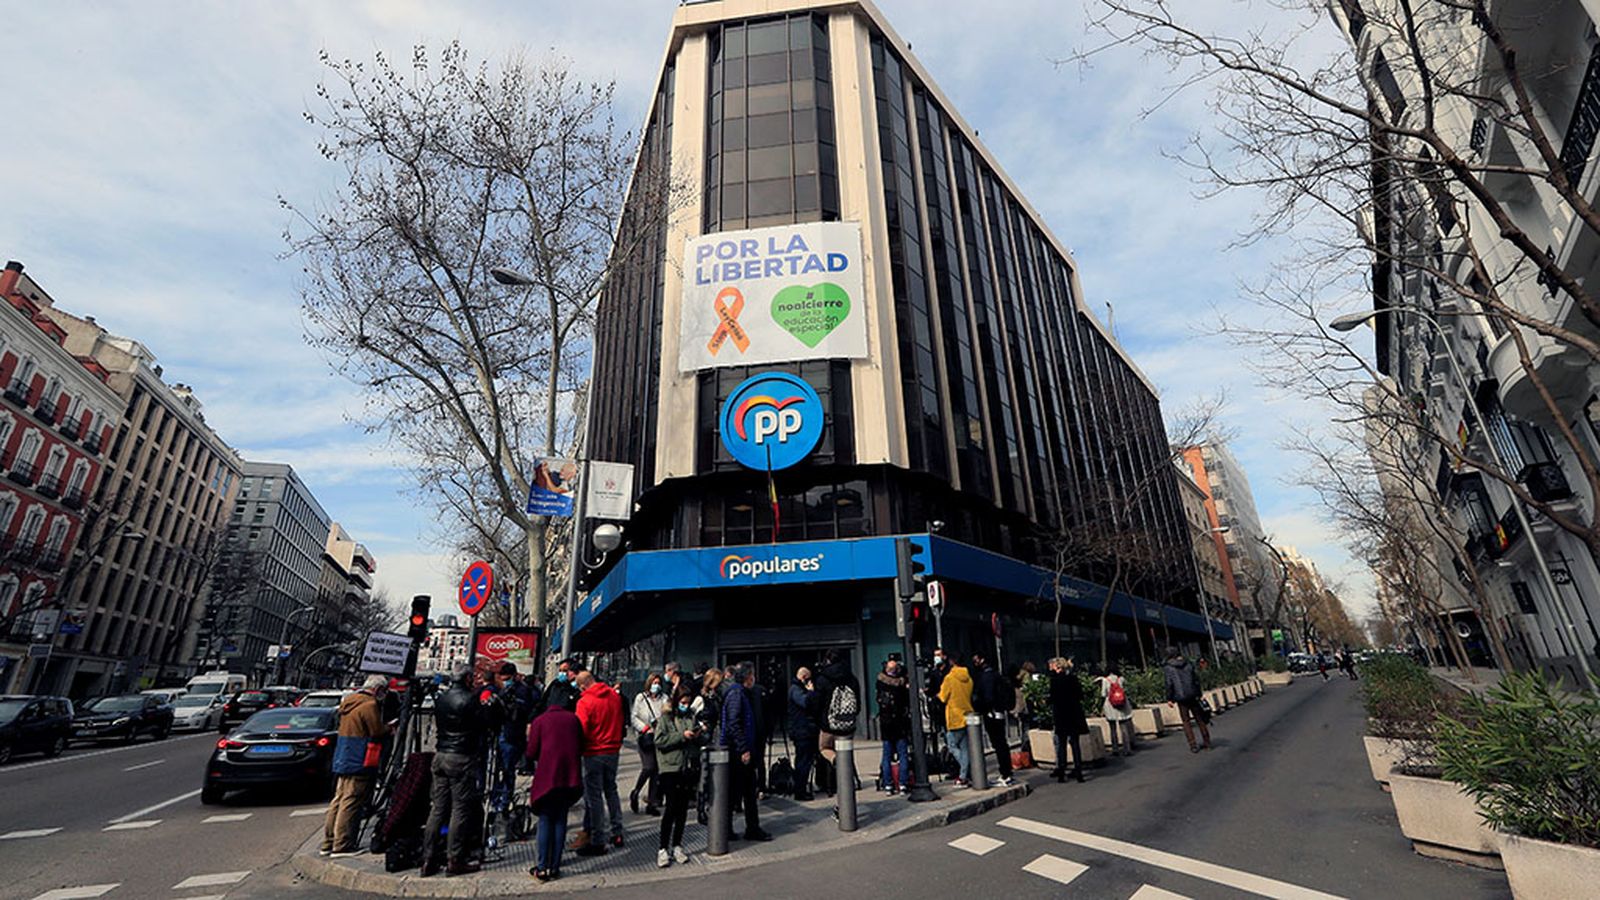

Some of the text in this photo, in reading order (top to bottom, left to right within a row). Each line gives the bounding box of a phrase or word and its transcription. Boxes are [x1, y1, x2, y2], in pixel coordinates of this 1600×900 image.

[696, 234, 809, 264] POR LA
[696, 252, 849, 285] LIBERTAD
[778, 299, 843, 312] noalcierre
[788, 322, 834, 335] especial
[729, 556, 821, 580] populares
[489, 639, 520, 650] nocilla
